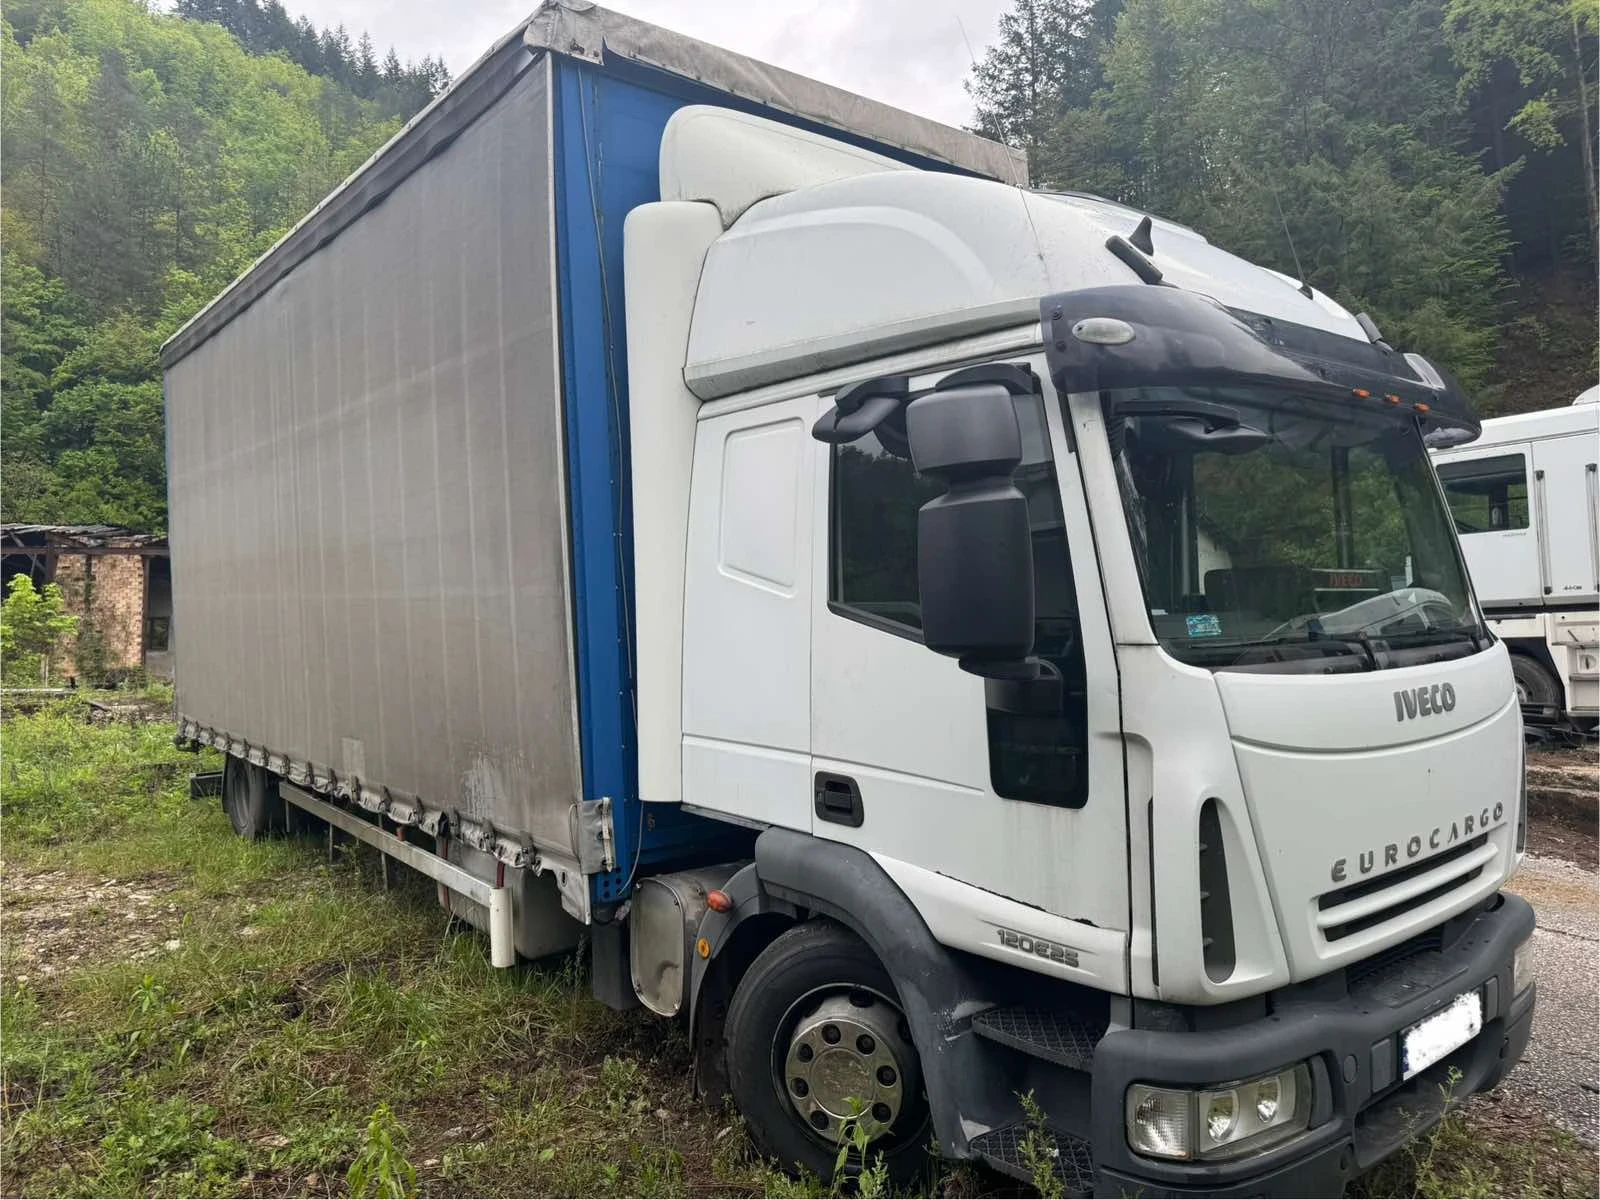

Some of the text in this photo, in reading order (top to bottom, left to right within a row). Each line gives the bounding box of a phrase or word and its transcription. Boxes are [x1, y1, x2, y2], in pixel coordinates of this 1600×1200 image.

[1393, 682, 1456, 722] IVECO
[1331, 802, 1503, 883] EUROCARGO
[997, 929, 1079, 968] 120E25
